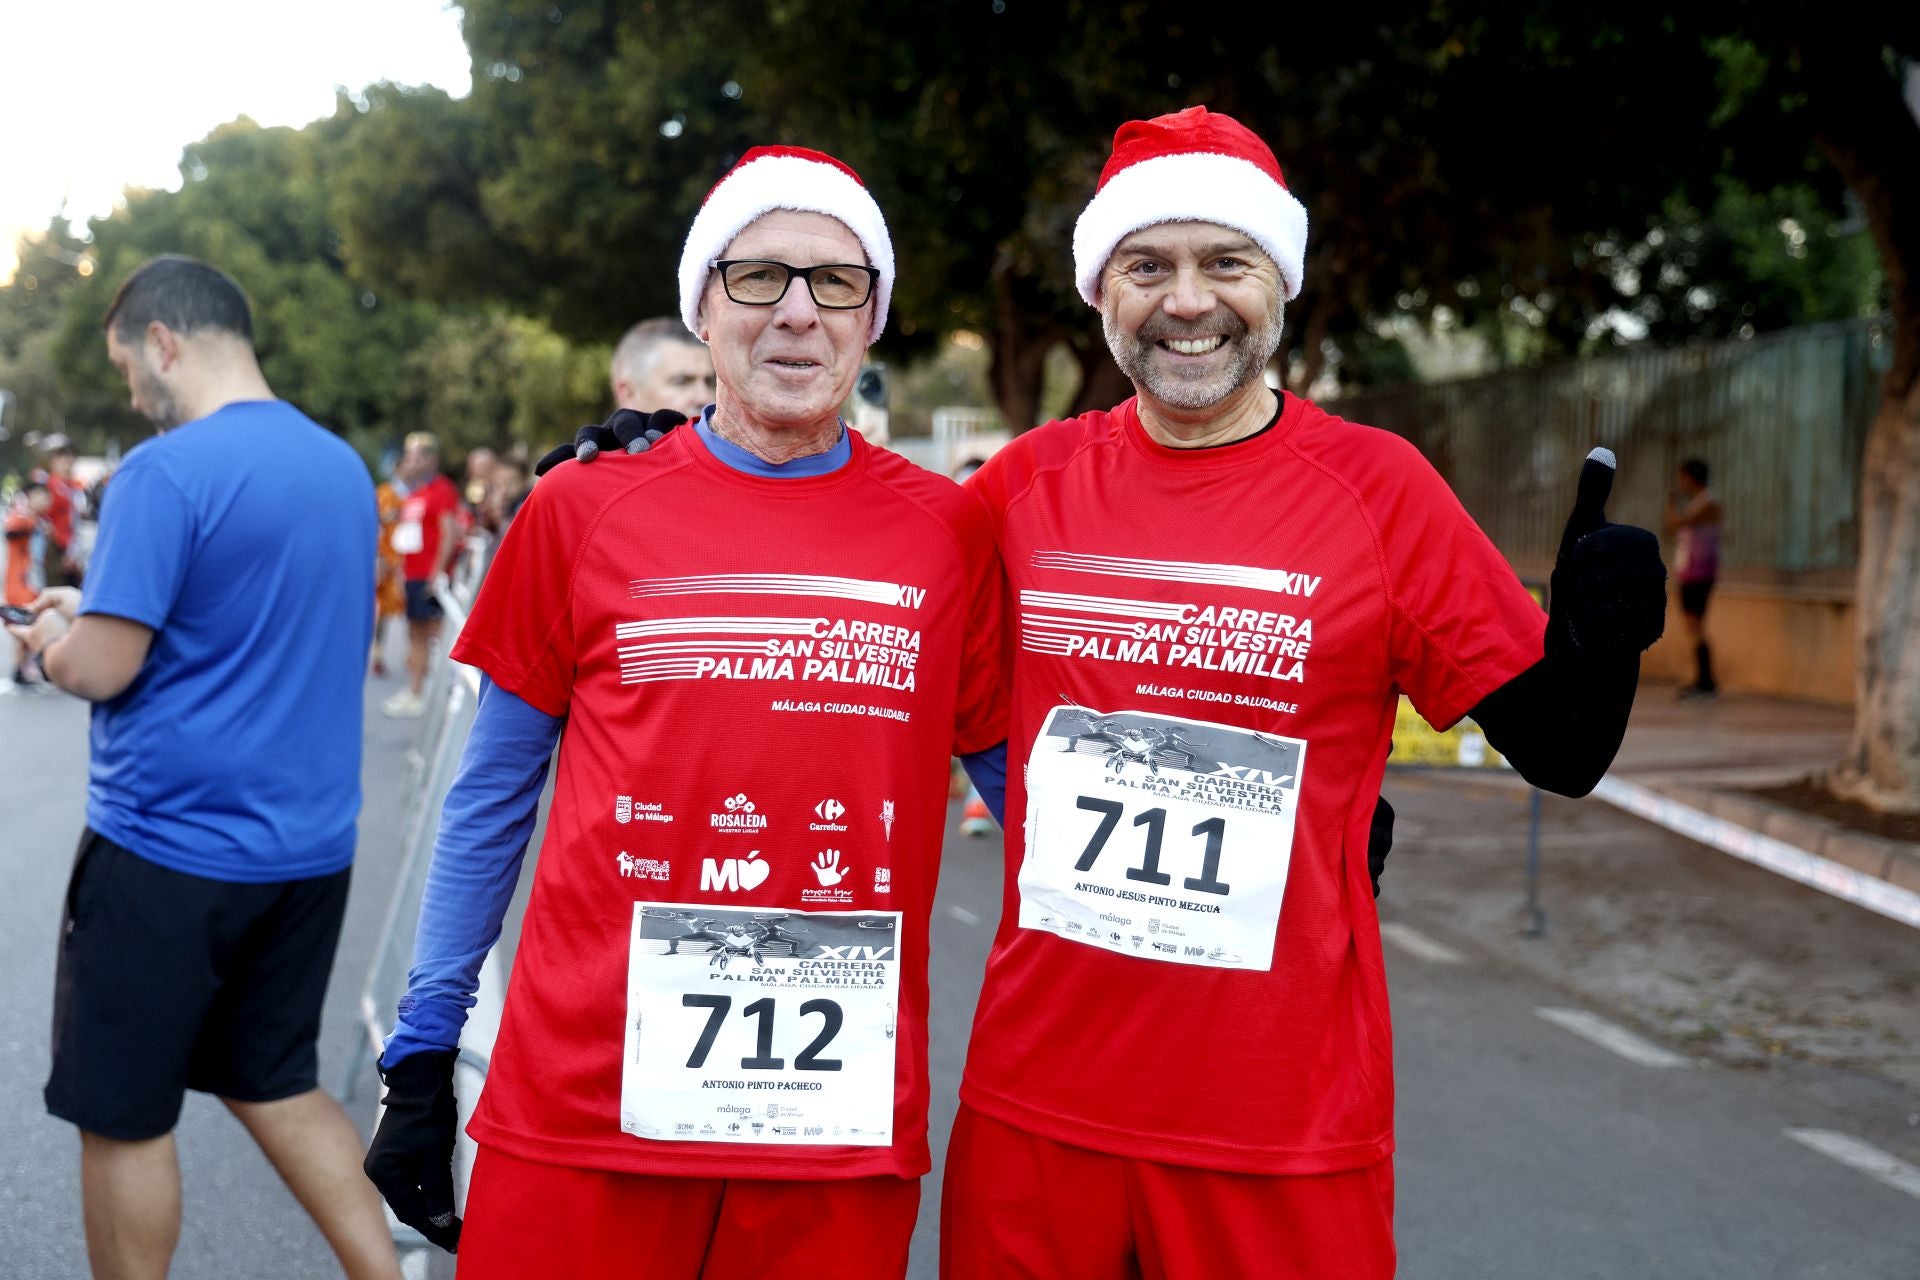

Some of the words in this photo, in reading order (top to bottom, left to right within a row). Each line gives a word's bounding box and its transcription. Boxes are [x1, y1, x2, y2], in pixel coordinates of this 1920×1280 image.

[1281, 570, 1321, 597] XIV
[896, 585, 926, 609] XIV
[809, 618, 920, 651] CARRERA
[1176, 604, 1312, 641] CARRERA
[1131, 622, 1180, 643] SAN
[1185, 626, 1311, 660] SILVESTRE
[765, 639, 814, 657] SAN
[819, 640, 919, 669] SILVESTRE
[1067, 635, 1159, 665] PALMA
[1167, 645, 1305, 683] PALMILLA
[697, 657, 794, 680] PALMA
[802, 659, 916, 692] PALMILLA
[771, 699, 821, 713] MÁLAGA
[824, 702, 866, 715] CIUDAD
[867, 706, 910, 722] SALUDABLE
[1136, 683, 1184, 698] MÁLAGA
[1186, 689, 1232, 703] CIUDAD
[1234, 694, 1298, 714] SALUDABLE
[1208, 761, 1294, 785] XIV
[1104, 776, 1171, 793] PALMA
[1181, 788, 1282, 812] PALMILLA
[1145, 775, 1180, 787] SAN
[1187, 782, 1283, 804] SILVESTRE
[1193, 775, 1284, 796] CARRERA
[635, 802, 662, 811] Ciudad
[635, 812, 644, 820] de
[646, 812, 673, 823] Málaga
[1192, 798, 1226, 808] CIUDAD
[1228, 804, 1281, 816] SALUDABLE
[711, 813, 767, 828] ROSALEDA
[810, 823, 847, 832] Carrefour
[1074, 795, 1230, 896] 711
[1074, 882, 1114, 897] ANTONIO
[1116, 889, 1146, 903] JESUS
[1148, 895, 1177, 908] PINTO
[1179, 901, 1221, 914] MEZCUA
[813, 945, 893, 960] XIV
[751, 967, 785, 975] SAN
[792, 968, 885, 978] SILVESTRE
[799, 961, 885, 970] CARRERA
[710, 974, 777, 982] PALMA
[787, 976, 885, 985] PALMILLA
[682, 993, 844, 1071] 712
[702, 1079, 745, 1090] ANTONIO
[747, 1080, 775, 1090] PINTO
[777, 1081, 822, 1091] PACHECO
